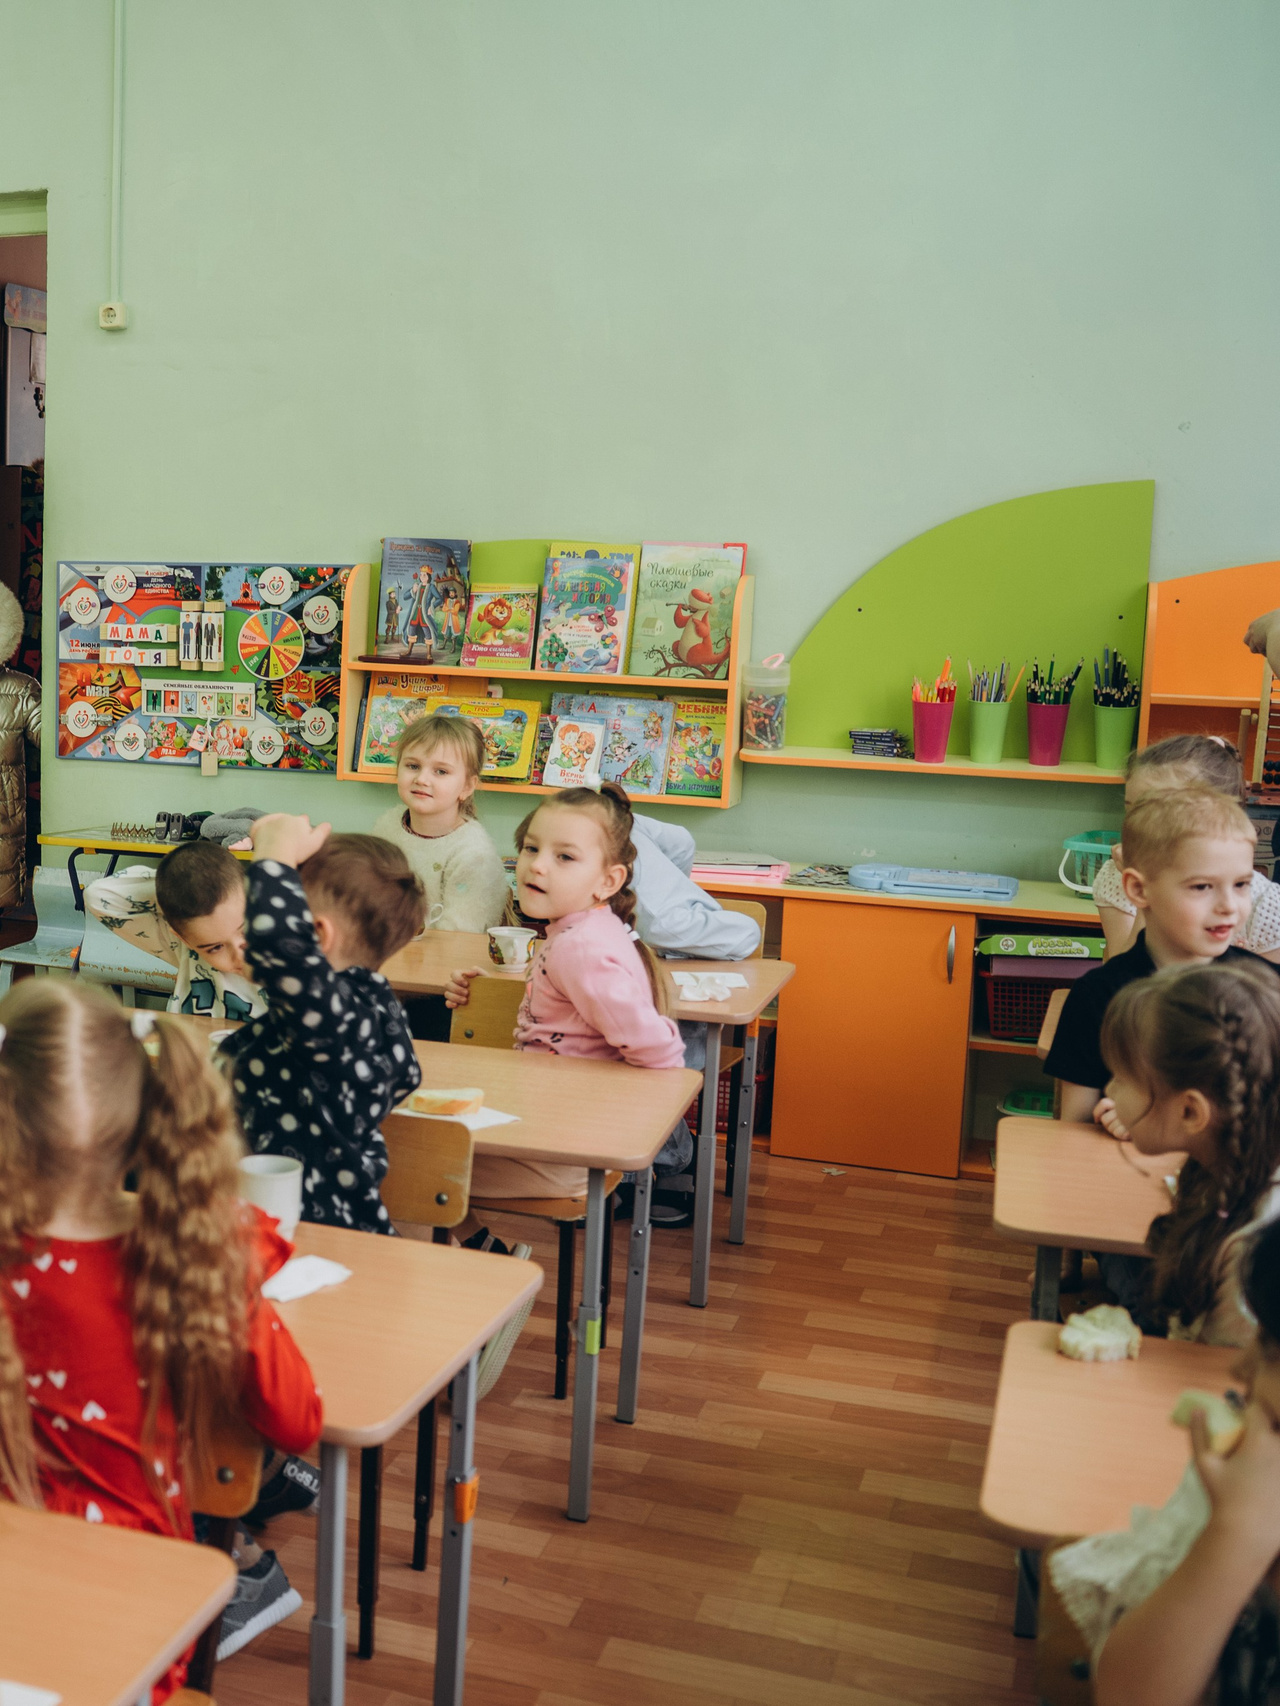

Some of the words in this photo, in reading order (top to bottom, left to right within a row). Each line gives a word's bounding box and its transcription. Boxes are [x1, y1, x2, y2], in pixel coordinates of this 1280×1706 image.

[647, 562, 714, 578] Плюшевые
[554, 580, 606, 592] ВОЛШЕБНАЯ
[650, 580, 687, 592] сказки
[572, 592, 611, 604] ИСТОРИЯ
[109, 626, 162, 640] МАМА
[109, 650, 162, 665] ТОТЯ
[288, 679, 310, 692] 23
[400, 675, 426, 688] Учим
[86, 686, 109, 697] Мая
[214, 724, 232, 753] 8
[220, 744, 246, 758] Марта
[688, 783, 720, 792] ИГРУШЕК
[1033, 938, 1072, 948] Новая
